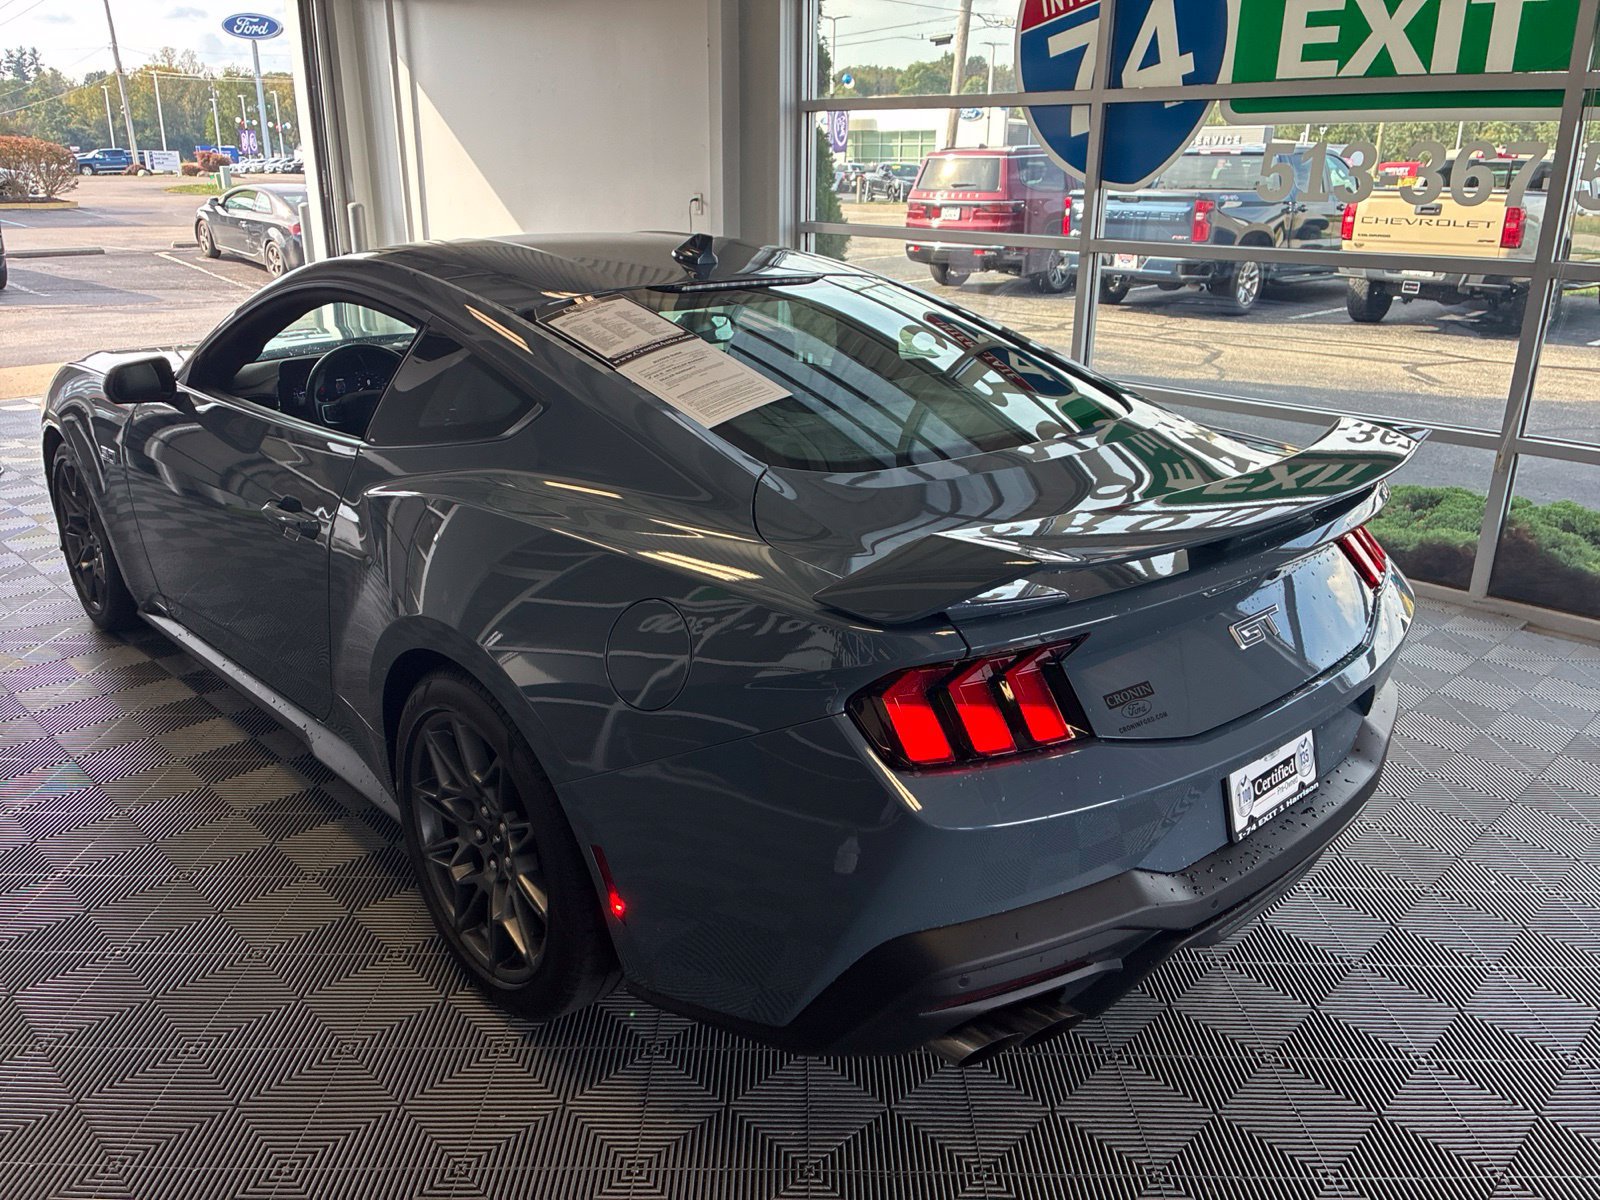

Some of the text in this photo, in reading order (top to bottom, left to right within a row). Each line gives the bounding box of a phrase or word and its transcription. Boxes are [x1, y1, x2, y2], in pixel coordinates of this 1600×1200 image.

[233, 16, 269, 34] Ford
[1276, 0, 1548, 79] EXIT
[1048, 0, 1195, 137] 74
[1361, 216, 1496, 229] CHEVROLET
[1227, 603, 1280, 650] GT
[1106, 683, 1152, 706] CRONIN
[1127, 702, 1148, 716] Ford
[1118, 711, 1168, 734] CRONINFORD.COM
[1254, 757, 1296, 796] Certified
[1238, 824, 1257, 841] I-74
[1258, 808, 1278, 827] EXIT
[1286, 782, 1319, 808] Harrison
